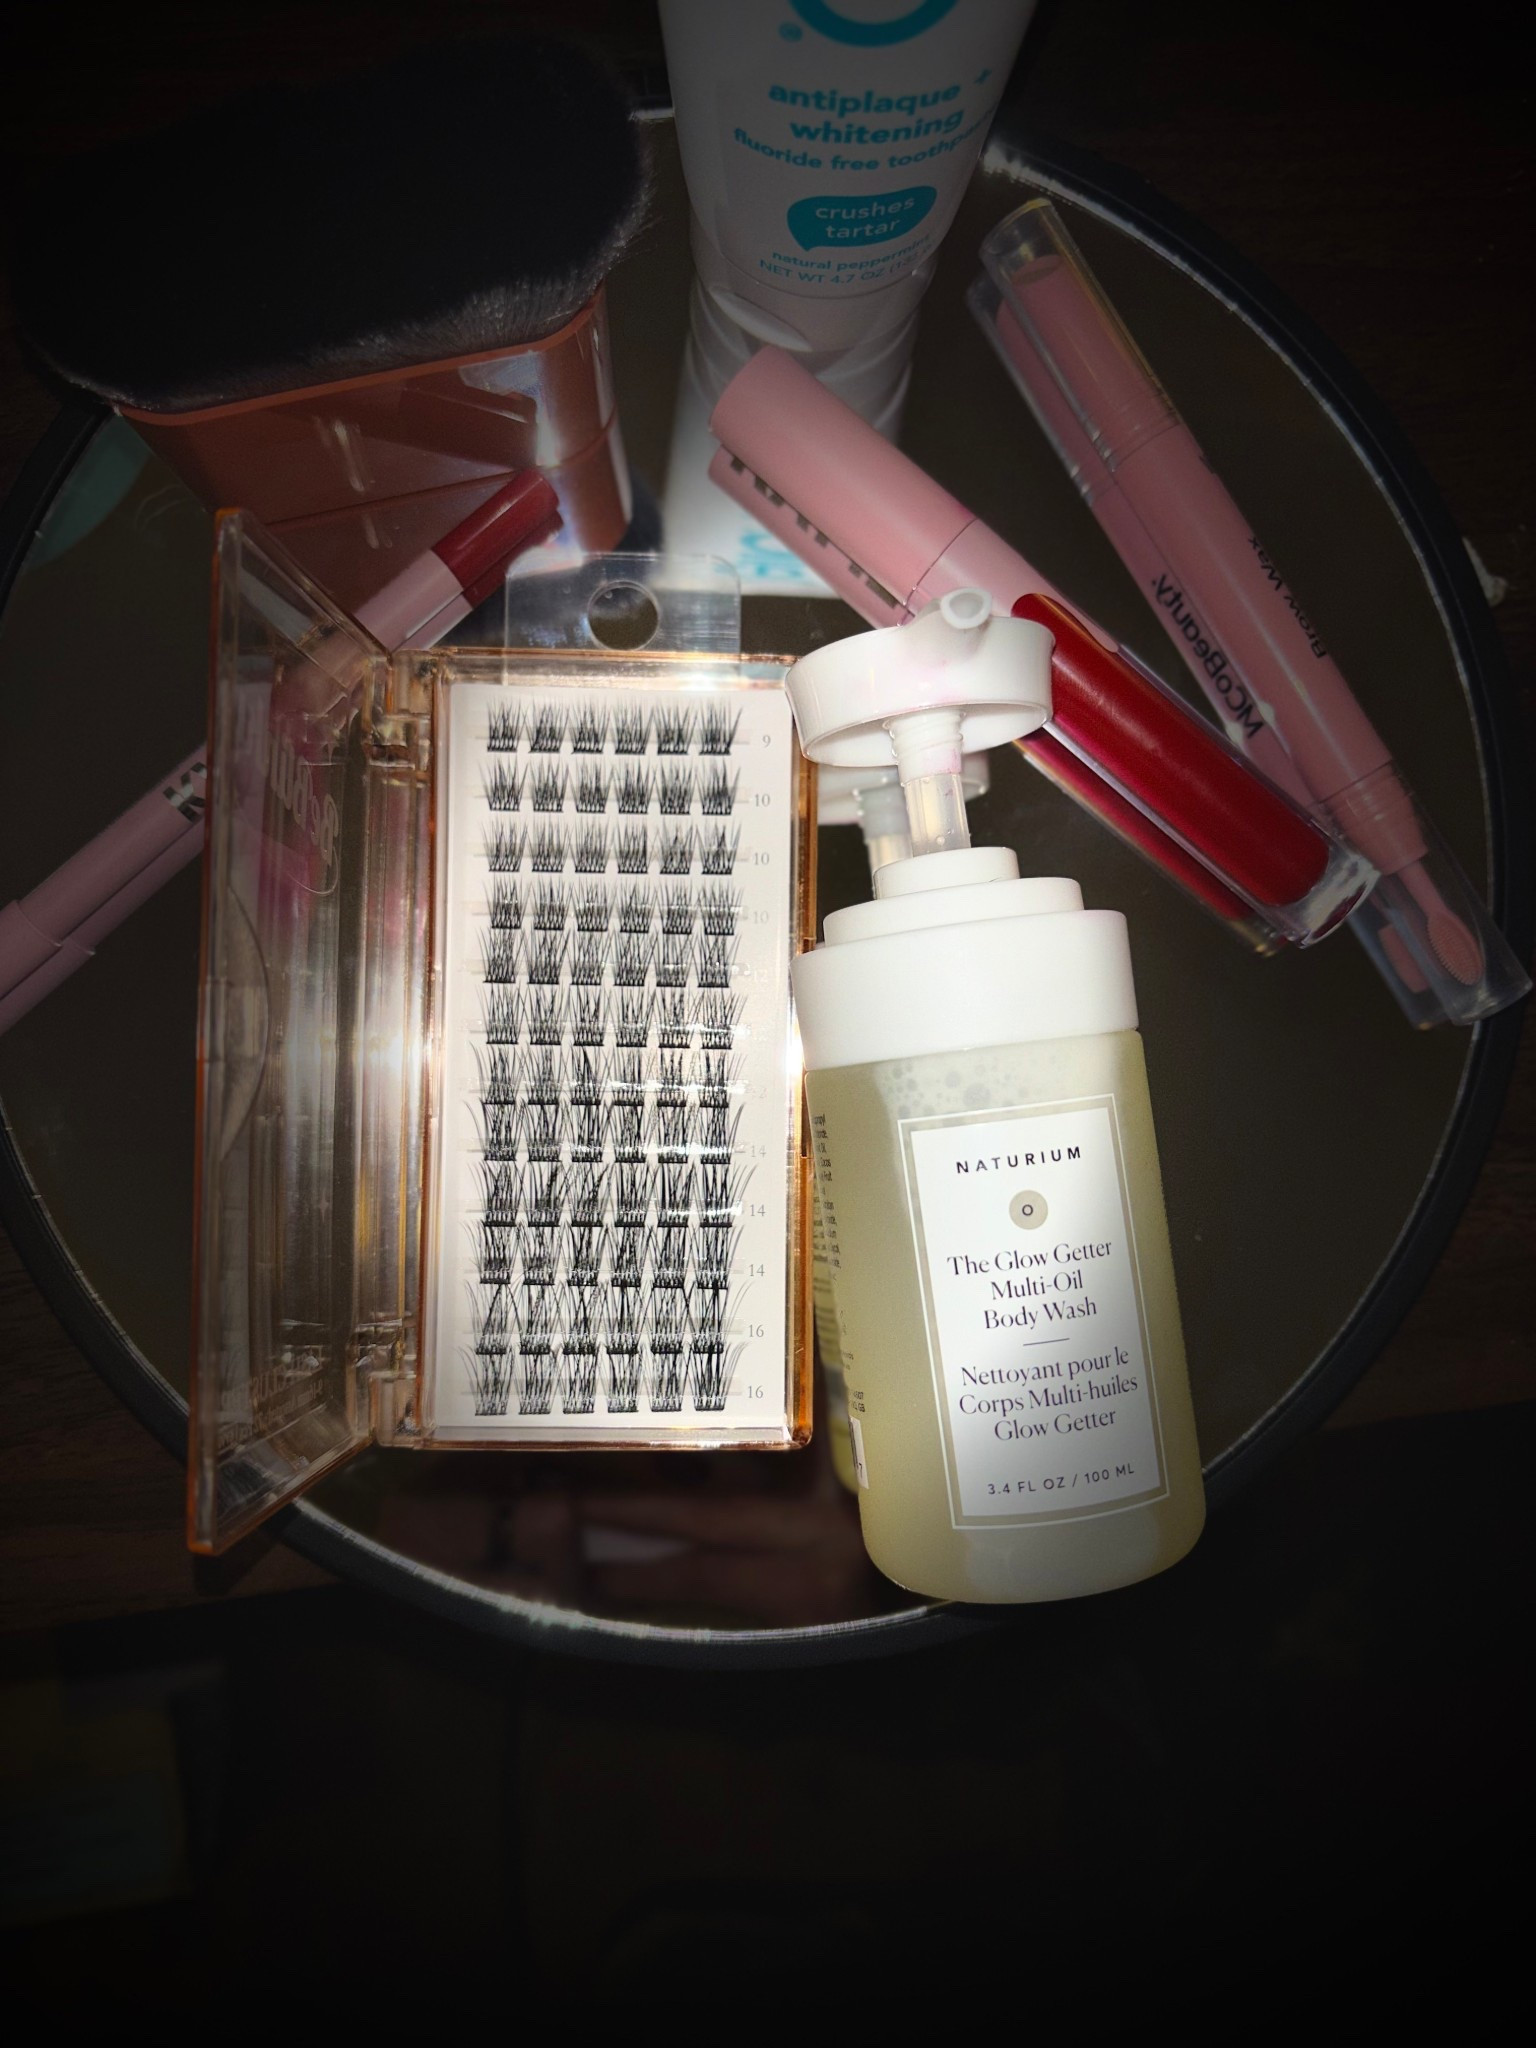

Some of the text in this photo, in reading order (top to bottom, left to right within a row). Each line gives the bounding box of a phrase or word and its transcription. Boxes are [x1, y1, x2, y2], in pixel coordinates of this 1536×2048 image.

[768, 83, 961, 118] antiplaque
[789, 109, 966, 145] whitening
[733, 127, 823, 170] fluoride
[830, 155, 880, 171] free
[814, 197, 916, 221] crushes
[824, 218, 902, 240] tartar
[771, 233, 932, 272] natural peppermint
[759, 258, 793, 278] NET
[797, 272, 826, 285] WT
[830, 272, 856, 285] 4.7
[860, 267, 886, 282] OZ
[1247, 536, 1284, 591] Wax
[762, 734, 771, 748] 9
[753, 793, 771, 807] 10
[752, 852, 770, 866] 10
[751, 910, 770, 925] 10
[749, 1145, 767, 1158] 14
[956, 1146, 1081, 1174] NATURIUM
[749, 1204, 766, 1217] 14
[748, 1264, 766, 1277] 14
[947, 1241, 1112, 1276] The Glow Getter
[990, 1269, 1084, 1301] Multi-Oil
[983, 1296, 1097, 1330] Body Wash
[747, 1325, 765, 1338] 16
[960, 1346, 1129, 1387] Nettoyant pour le
[746, 1385, 764, 1399] 16
[959, 1374, 1138, 1417] Corps Multi-huiles
[994, 1410, 1116, 1441] Glow Getter
[987, 1463, 1135, 1495] 3.4 FL OZ / 100 ML
